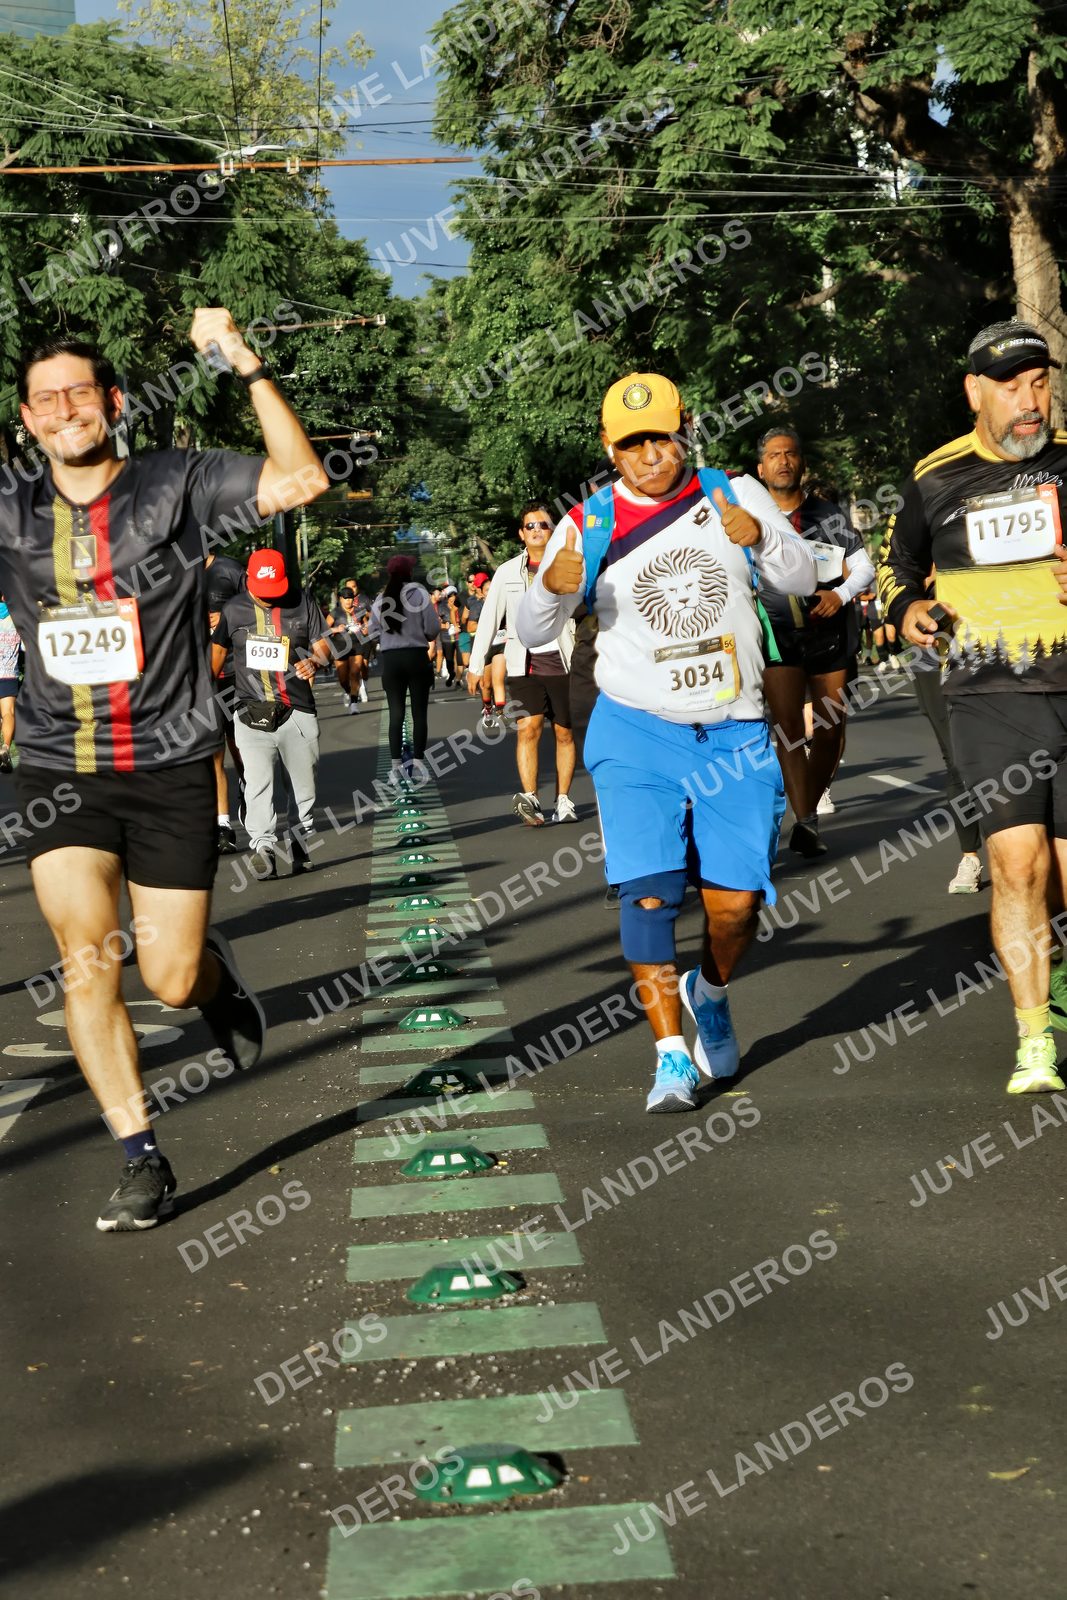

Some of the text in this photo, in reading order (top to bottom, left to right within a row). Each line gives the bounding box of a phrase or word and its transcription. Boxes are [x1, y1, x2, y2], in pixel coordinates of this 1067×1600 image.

[974, 508, 1048, 541] 11795
[45, 625, 127, 657] 12249
[251, 646, 279, 659] 6503
[724, 639, 733, 649] 5K
[670, 660, 724, 691] 3034
